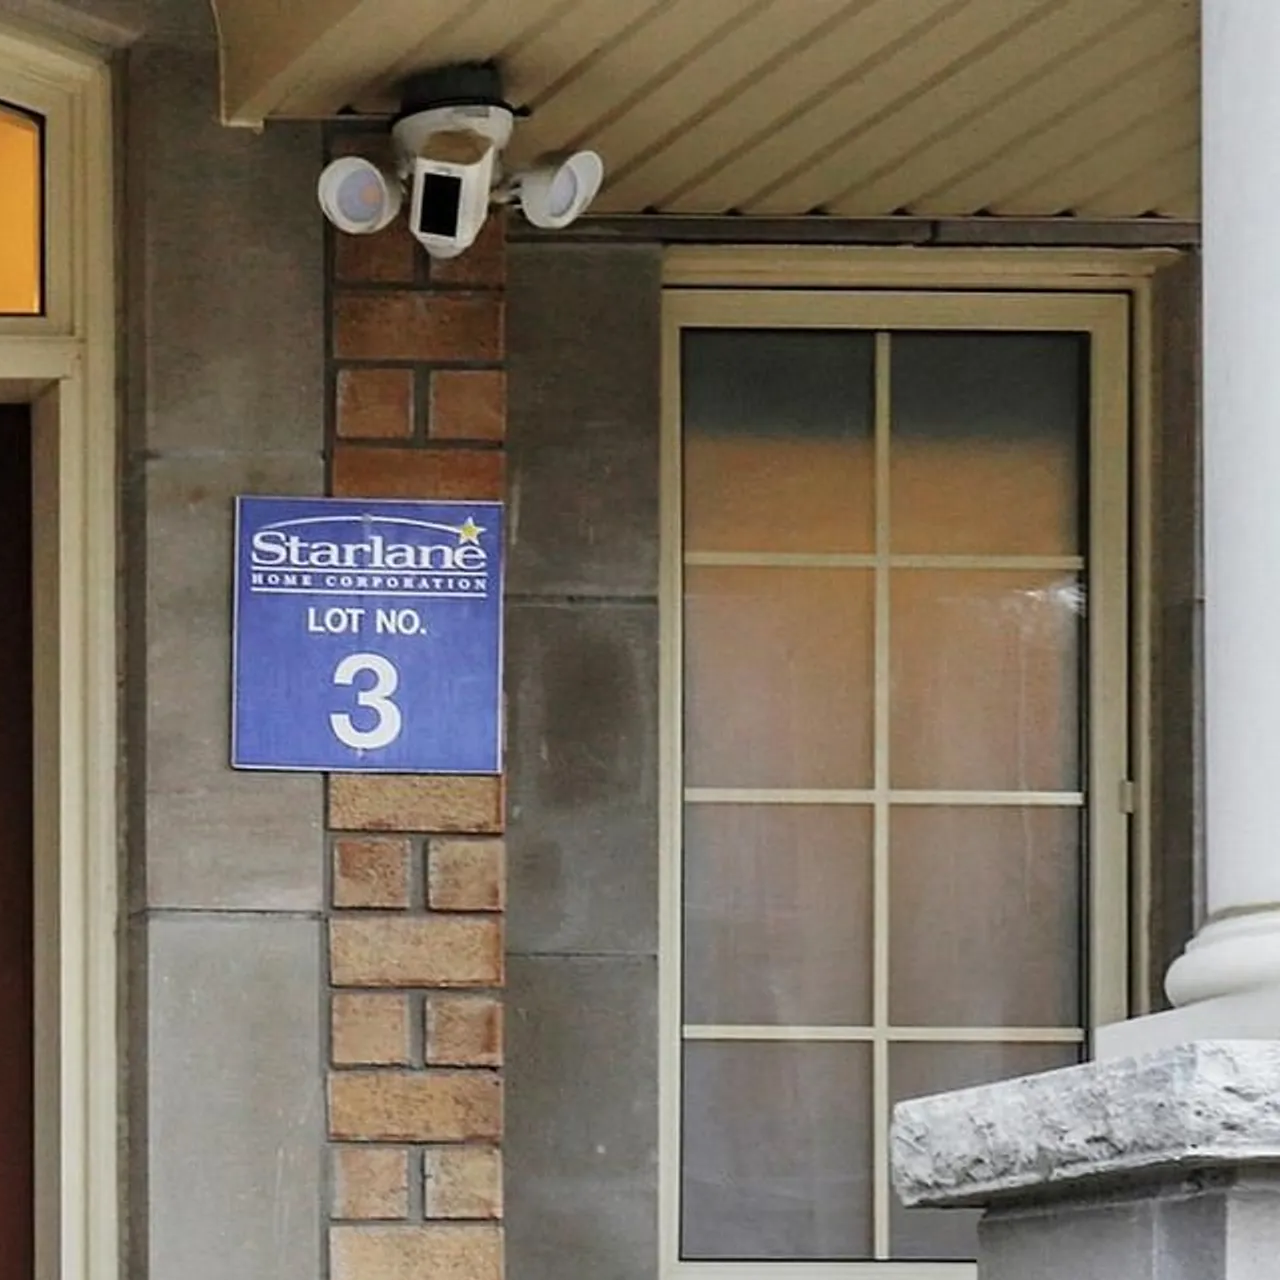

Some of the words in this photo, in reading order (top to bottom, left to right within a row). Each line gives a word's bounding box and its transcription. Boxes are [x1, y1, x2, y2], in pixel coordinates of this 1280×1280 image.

[251, 530, 488, 570] Starlane
[251, 573, 313, 586] HOME
[326, 575, 488, 590] CORPORATION
[307, 607, 365, 633] LOT
[376, 608, 427, 635] NO.
[330, 652, 402, 750] 3
